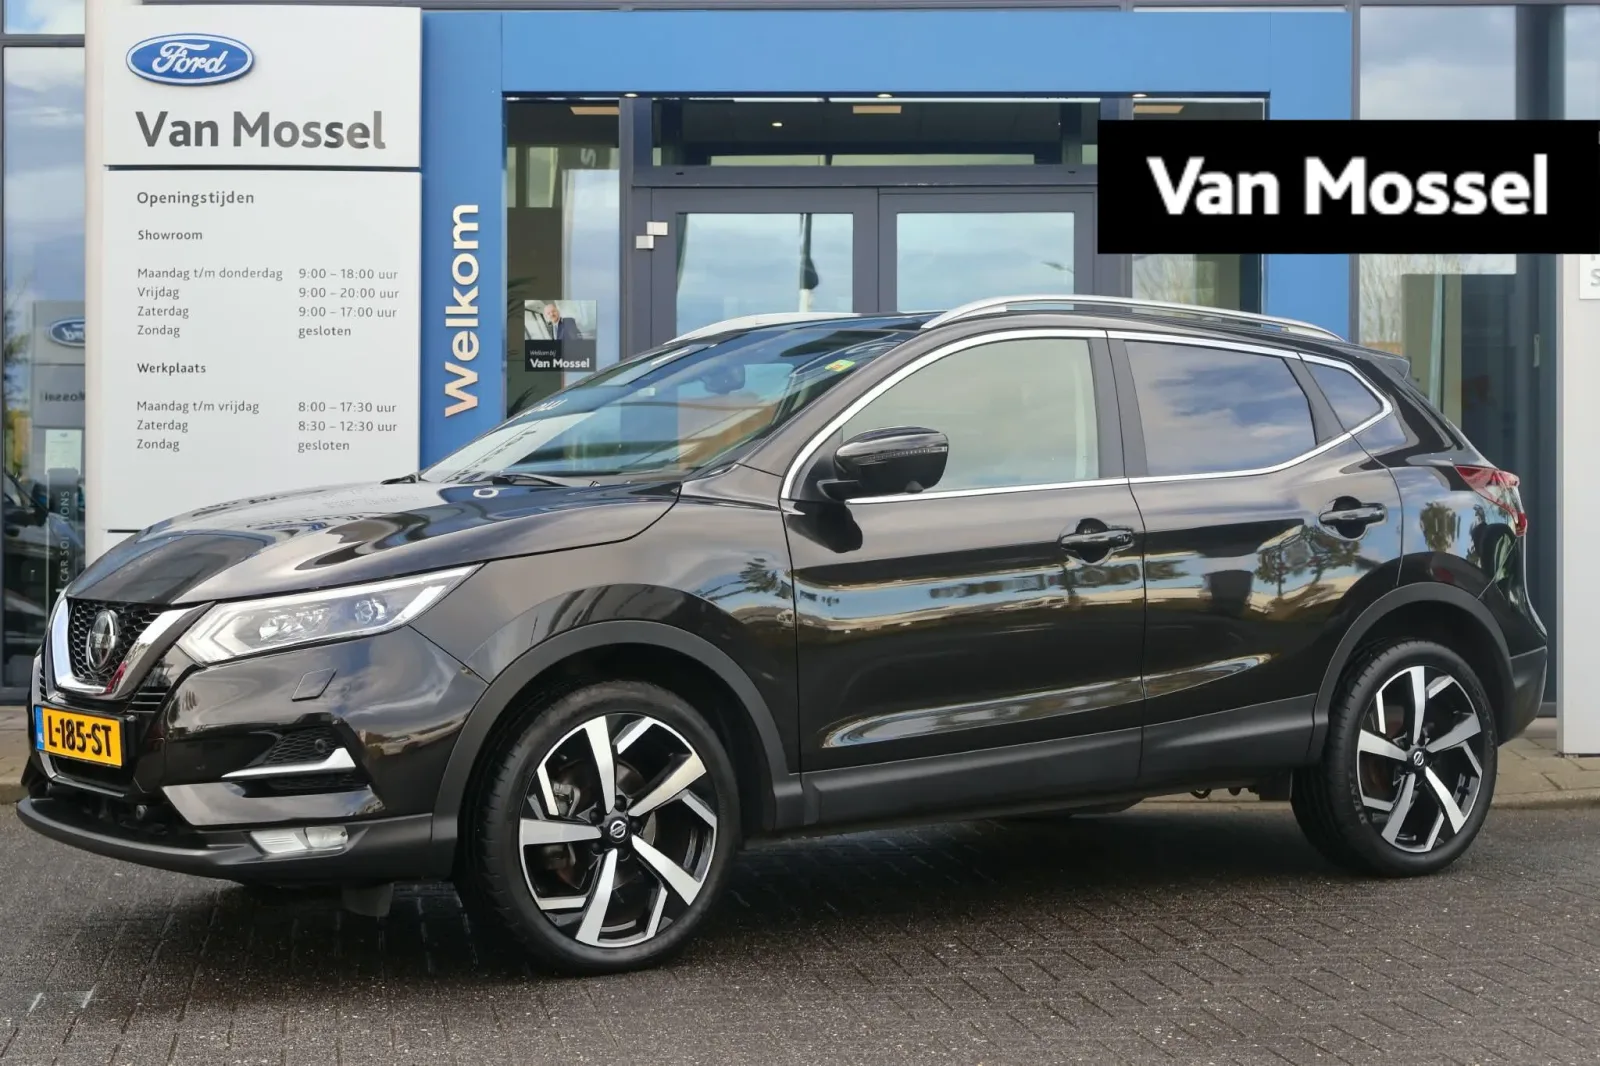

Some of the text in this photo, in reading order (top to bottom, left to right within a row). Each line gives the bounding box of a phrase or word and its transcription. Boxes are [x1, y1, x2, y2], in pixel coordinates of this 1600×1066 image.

[152, 41, 228, 75] Ford
[135, 110, 387, 149] Van Mossel
[136, 191, 254, 207] Openingstijden
[137, 229, 203, 241] Showroom
[137, 267, 190, 281] Maandag
[194, 267, 216, 279] t/m
[219, 267, 283, 281] donderdag
[298, 268, 327, 279] 9:00
[340, 268, 375, 279] 18:00
[378, 271, 398, 279] uur
[137, 286, 180, 301] Vrijdag
[298, 287, 327, 299] 9:00
[340, 287, 376, 299] 20:00
[379, 290, 400, 299] uur
[137, 305, 190, 320] Zaterdag
[298, 306, 327, 318] 9:00
[340, 306, 374, 318] 17:00
[377, 309, 397, 318] uur
[444, 203, 480, 417] Welkom
[137, 324, 352, 340] Zondag gesloten
[137, 362, 207, 376] Werkplaats
[530, 357, 590, 368] Van Mossel
[136, 400, 189, 414] Maandag
[193, 400, 215, 412] t/m
[219, 400, 260, 414] vrijdag
[298, 401, 326, 413] 8:00
[340, 401, 373, 413] 17:30
[376, 404, 397, 413] uur
[136, 419, 189, 434] Zaterdag
[298, 420, 326, 432] 8:30
[340, 420, 374, 432] 12:30
[377, 423, 398, 432] uur
[136, 438, 350, 454] Zondag gesloten
[48, 715, 112, 757] L-185-ST
